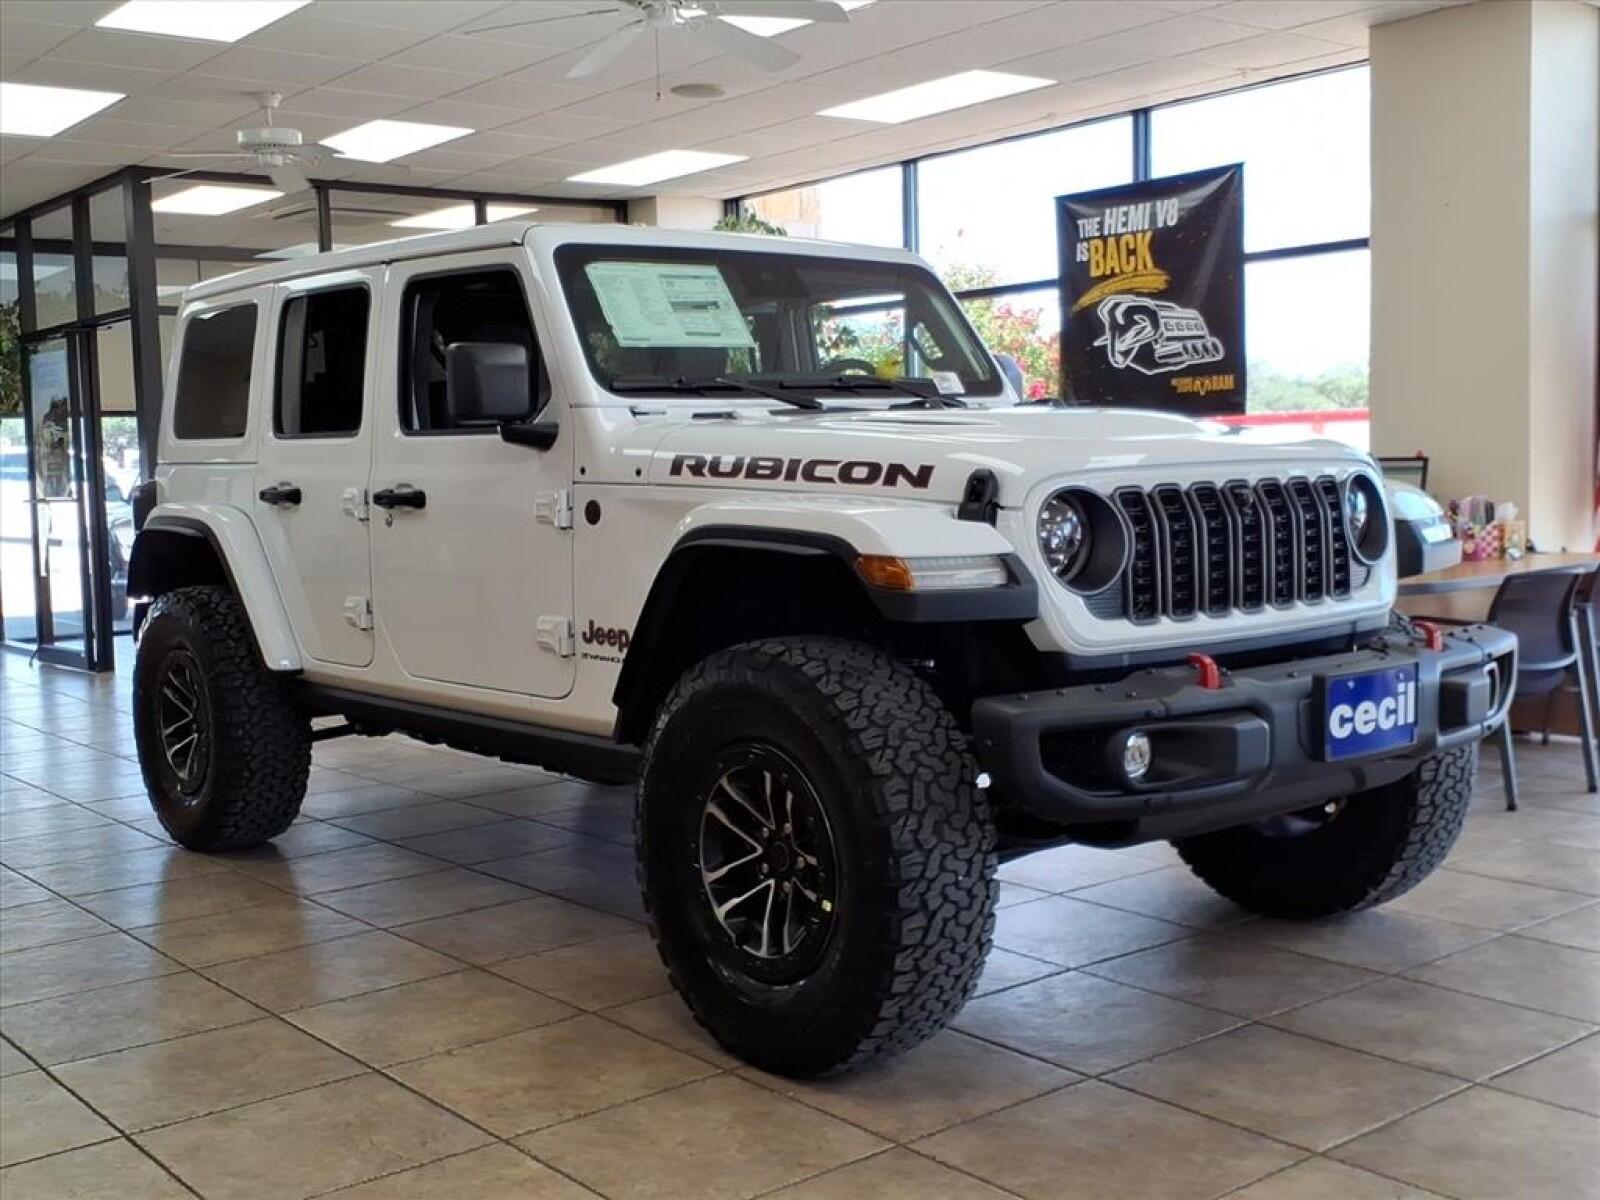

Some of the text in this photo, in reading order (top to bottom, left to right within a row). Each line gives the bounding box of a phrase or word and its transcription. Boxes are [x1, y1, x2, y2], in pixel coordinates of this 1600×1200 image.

[1076, 198, 1179, 239] THE HEMI V8
[1076, 230, 1154, 277] IS BACK
[669, 454, 935, 489] RUBICON
[582, 619, 630, 653] Jeep
[1329, 680, 1415, 739] cecil
